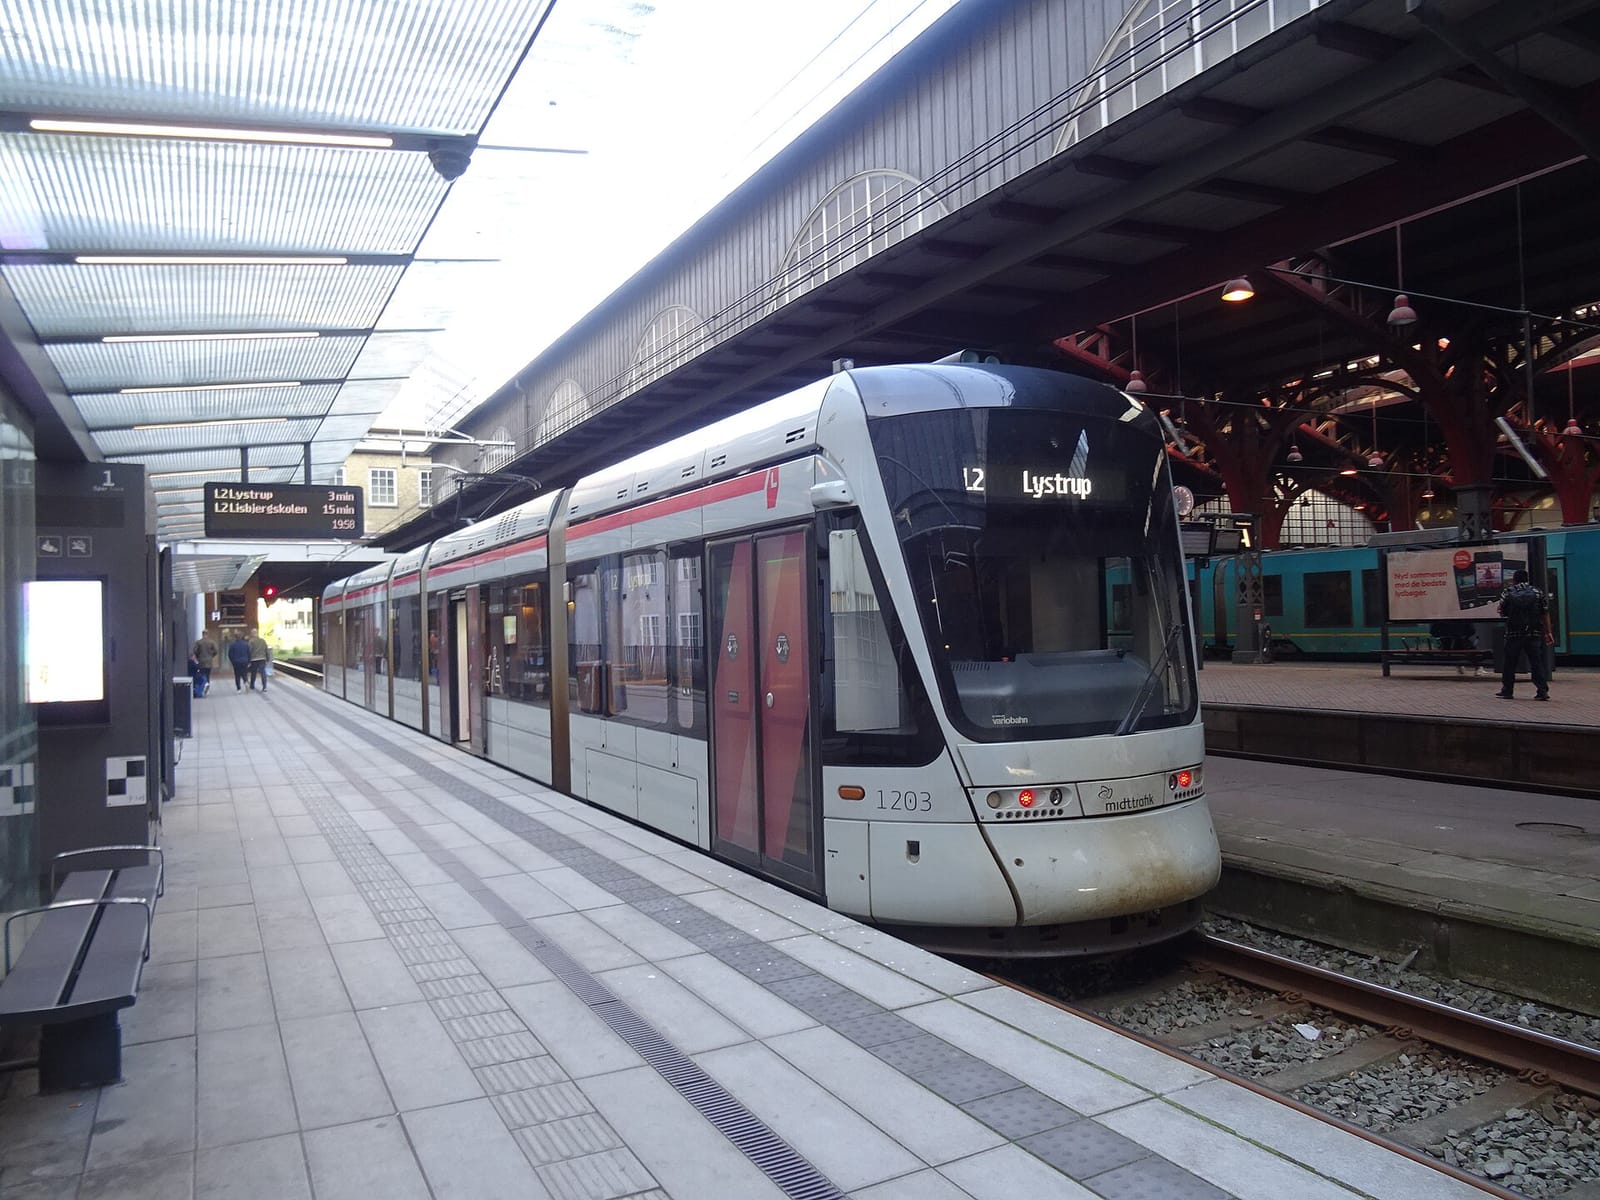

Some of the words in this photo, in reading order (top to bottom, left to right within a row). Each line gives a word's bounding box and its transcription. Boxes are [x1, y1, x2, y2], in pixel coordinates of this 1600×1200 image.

[103, 470, 115, 487] 1
[1022, 470, 1092, 500] Lystrup
[229, 489, 273, 500] Lystrup
[328, 491, 335, 501] 3
[335, 492, 354, 501] min
[322, 504, 336, 515] 15
[336, 505, 355, 515] min
[877, 789, 932, 812] 1203
[1105, 793, 1155, 812] midttrafik
